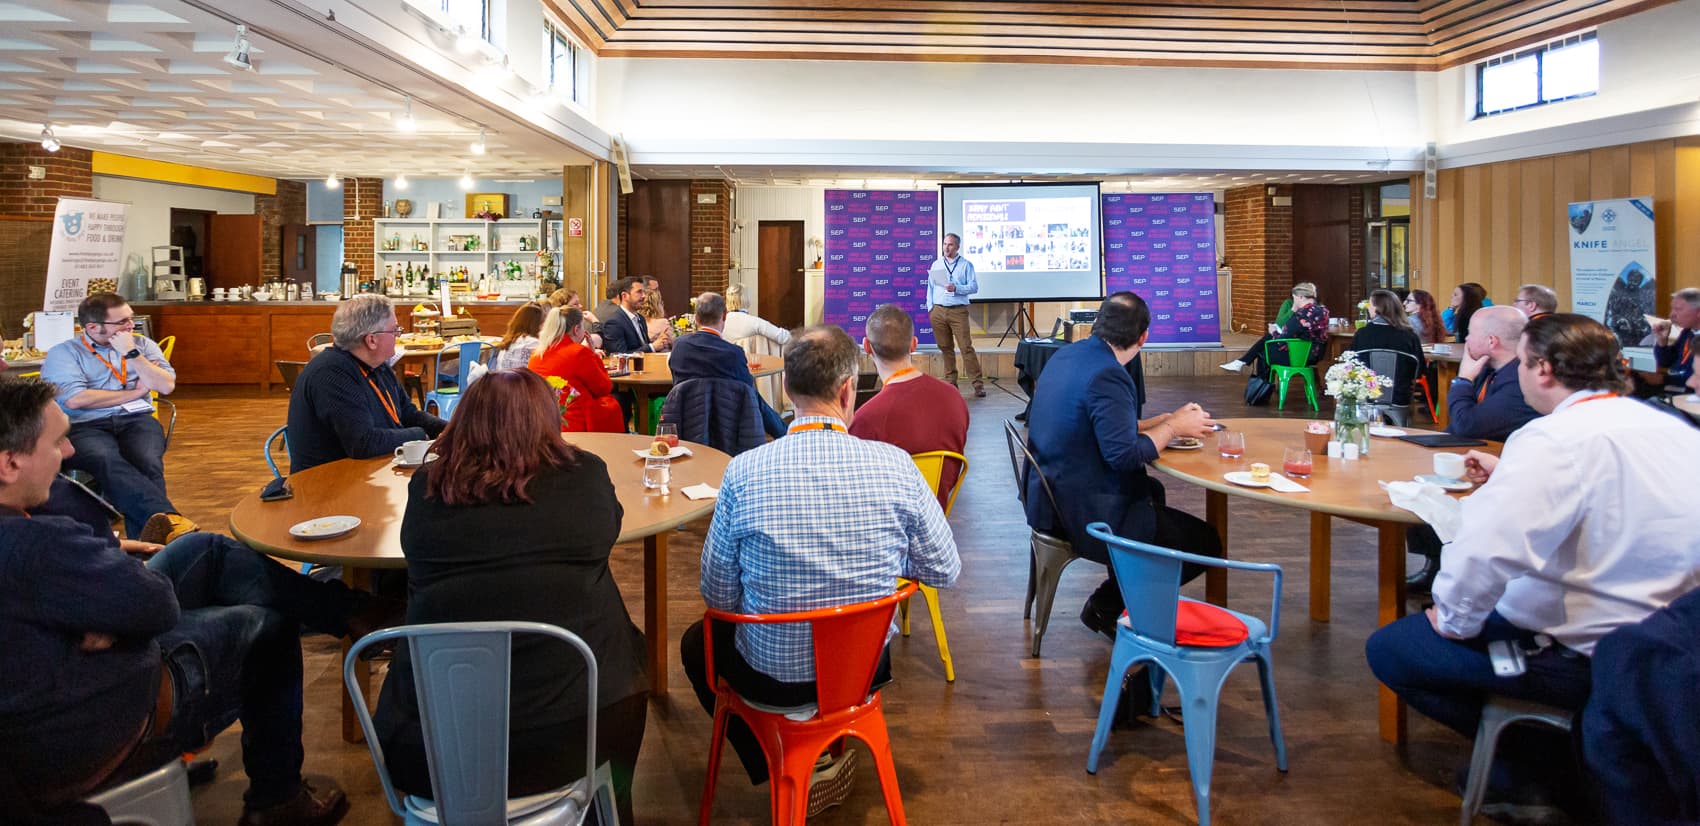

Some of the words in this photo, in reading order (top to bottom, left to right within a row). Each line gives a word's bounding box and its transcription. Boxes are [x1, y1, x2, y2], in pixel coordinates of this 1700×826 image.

[86, 234, 100, 242] FOOD
[1574, 240, 1608, 248] KNIFE
[62, 278, 80, 288] EVENT
[54, 288, 84, 300] CATERING
